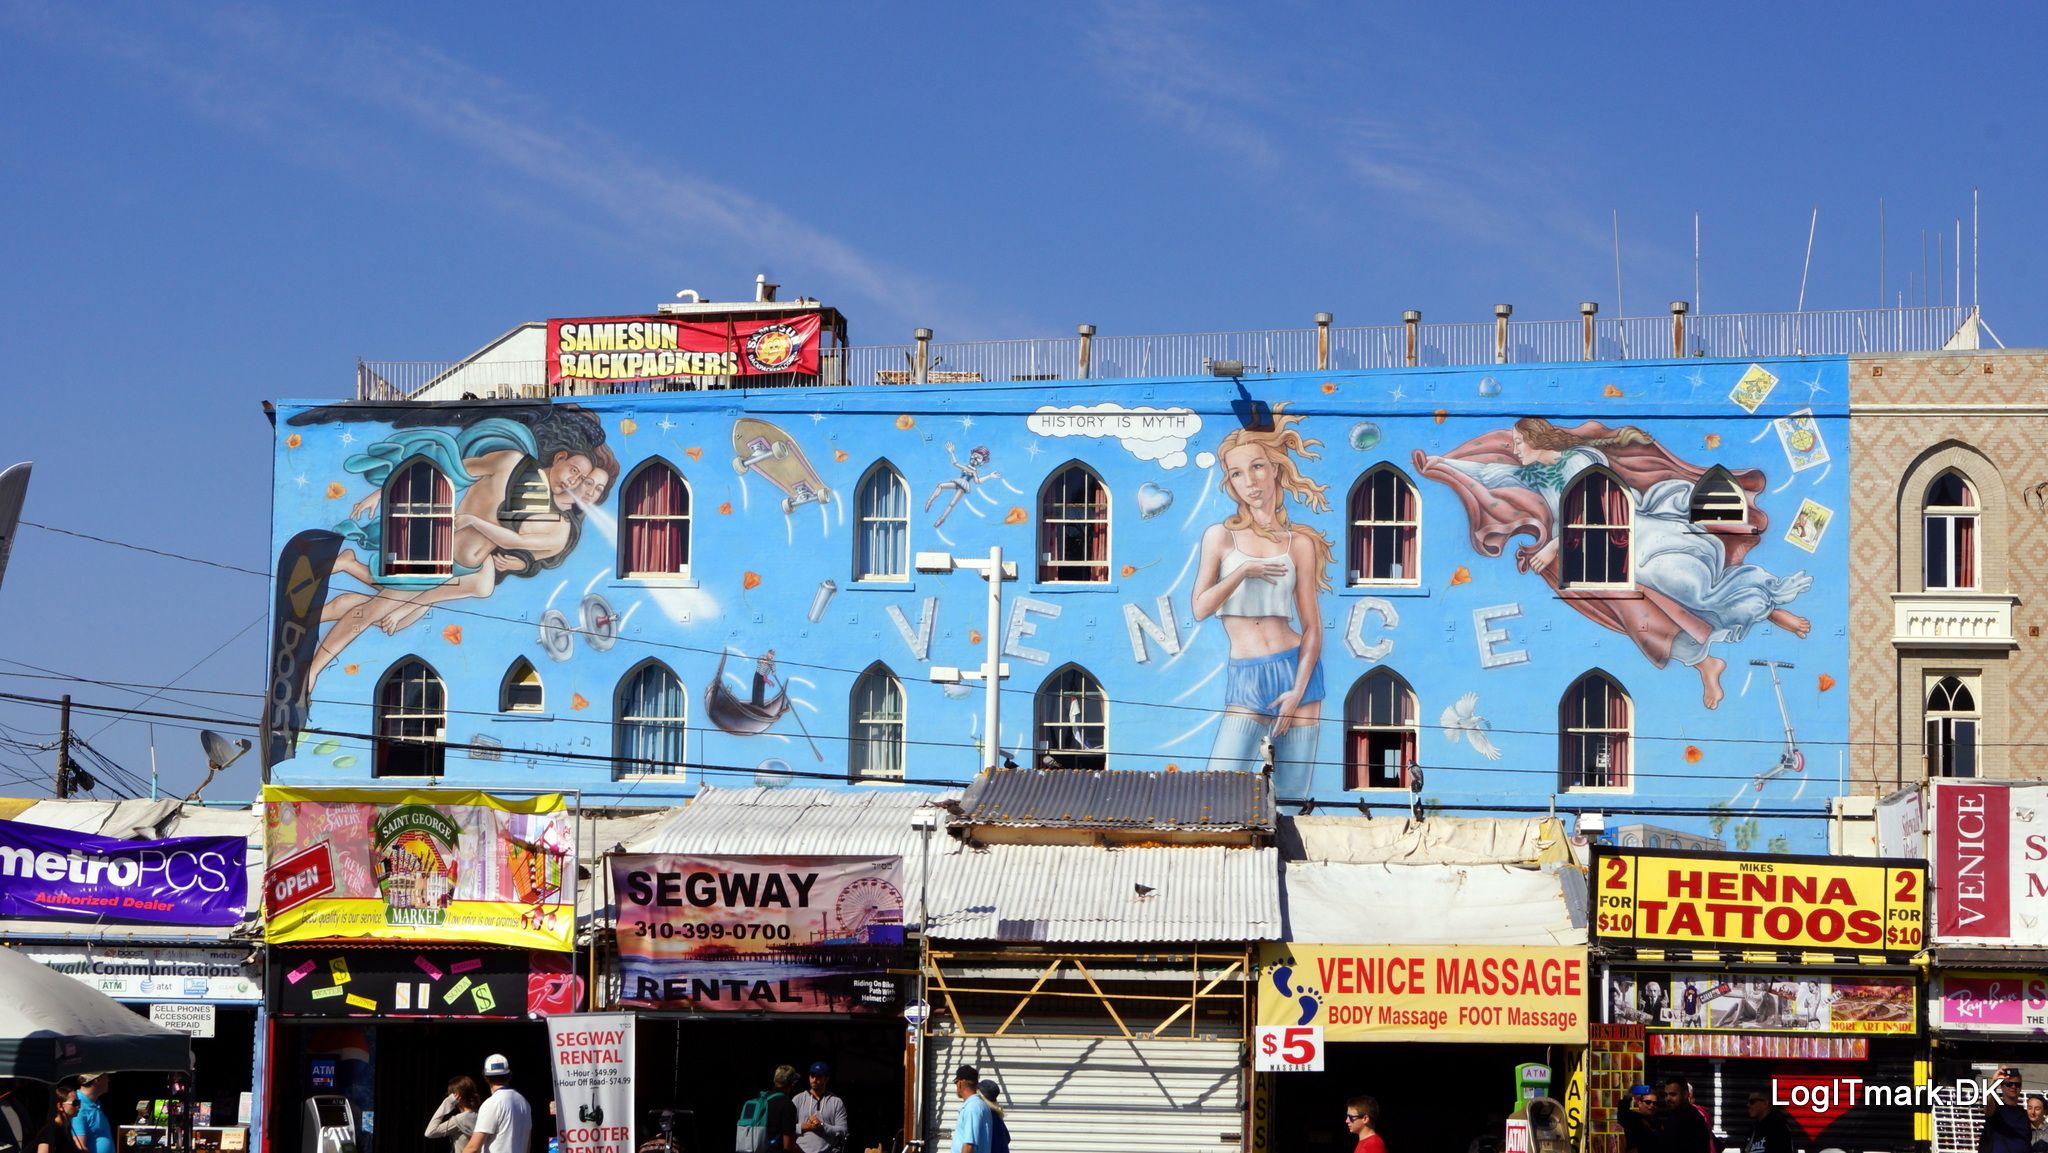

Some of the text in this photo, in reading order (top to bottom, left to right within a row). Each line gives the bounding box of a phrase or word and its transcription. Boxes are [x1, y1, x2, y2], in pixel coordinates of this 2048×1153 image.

[559, 322, 680, 352] SAMESUN
[559, 350, 738, 379] BACKPACKERS
[1042, 416, 1186, 428] HISTORY IS MYTH
[271, 620, 306, 760] boost
[382, 813, 452, 840] SAINT GEORGE
[1739, 863, 1774, 873] MIKES
[1957, 793, 1986, 928] VENICE
[275, 866, 319, 901] OPEN
[1605, 858, 1628, 890] 2
[626, 870, 819, 908] SEGWAY
[1667, 869, 1858, 906] HENNA
[1894, 871, 1917, 903] 2
[35, 892, 175, 911] Authorized Dealer
[1599, 895, 1632, 909] FOR
[392, 908, 439, 925] MARKET
[1598, 912, 1632, 933] $10
[1638, 900, 1884, 944] TATTOOS
[1888, 909, 1921, 922] FOR
[634, 921, 791, 940] 310-399-0700
[1887, 925, 1921, 945] $10
[118, 949, 145, 957] boost
[210, 951, 237, 959] metro
[47, 960, 240, 978] walk Communications
[1317, 957, 1581, 996] VENICE MASSAGE
[102, 981, 122, 989] ATM
[157, 982, 172, 990] at&t
[446, 980, 469, 1001] SODA
[636, 976, 803, 1003] RENTAL
[853, 980, 873, 988] Riding
[475, 988, 491, 1010] $
[2028, 980, 2047, 1010] S
[154, 1013, 211, 1021] ACCESSORIES
[155, 1005, 211, 1013] CELL PHONES
[1328, 1005, 1577, 1031] BODY Massage FOOT Massage
[165, 1021, 200, 1029] PREPAID
[1832, 1021, 1913, 1032] MORE ART INSIDE
[2026, 1016, 2045, 1024] THE
[555, 1030, 625, 1047] SEGWAY
[1262, 1028, 1316, 1064] $5
[560, 1049, 623, 1065] RENTAL
[312, 1066, 335, 1075] ATM
[567, 1069, 590, 1077] 1-Hour
[595, 1068, 617, 1077] $49.99
[1525, 1070, 1547, 1078] ATM
[578, 1079, 588, 1087] Off
[609, 1077, 631, 1086] $74.99
[559, 1126, 630, 1143] SCOOTER
[1507, 1127, 1527, 1152] ATM
